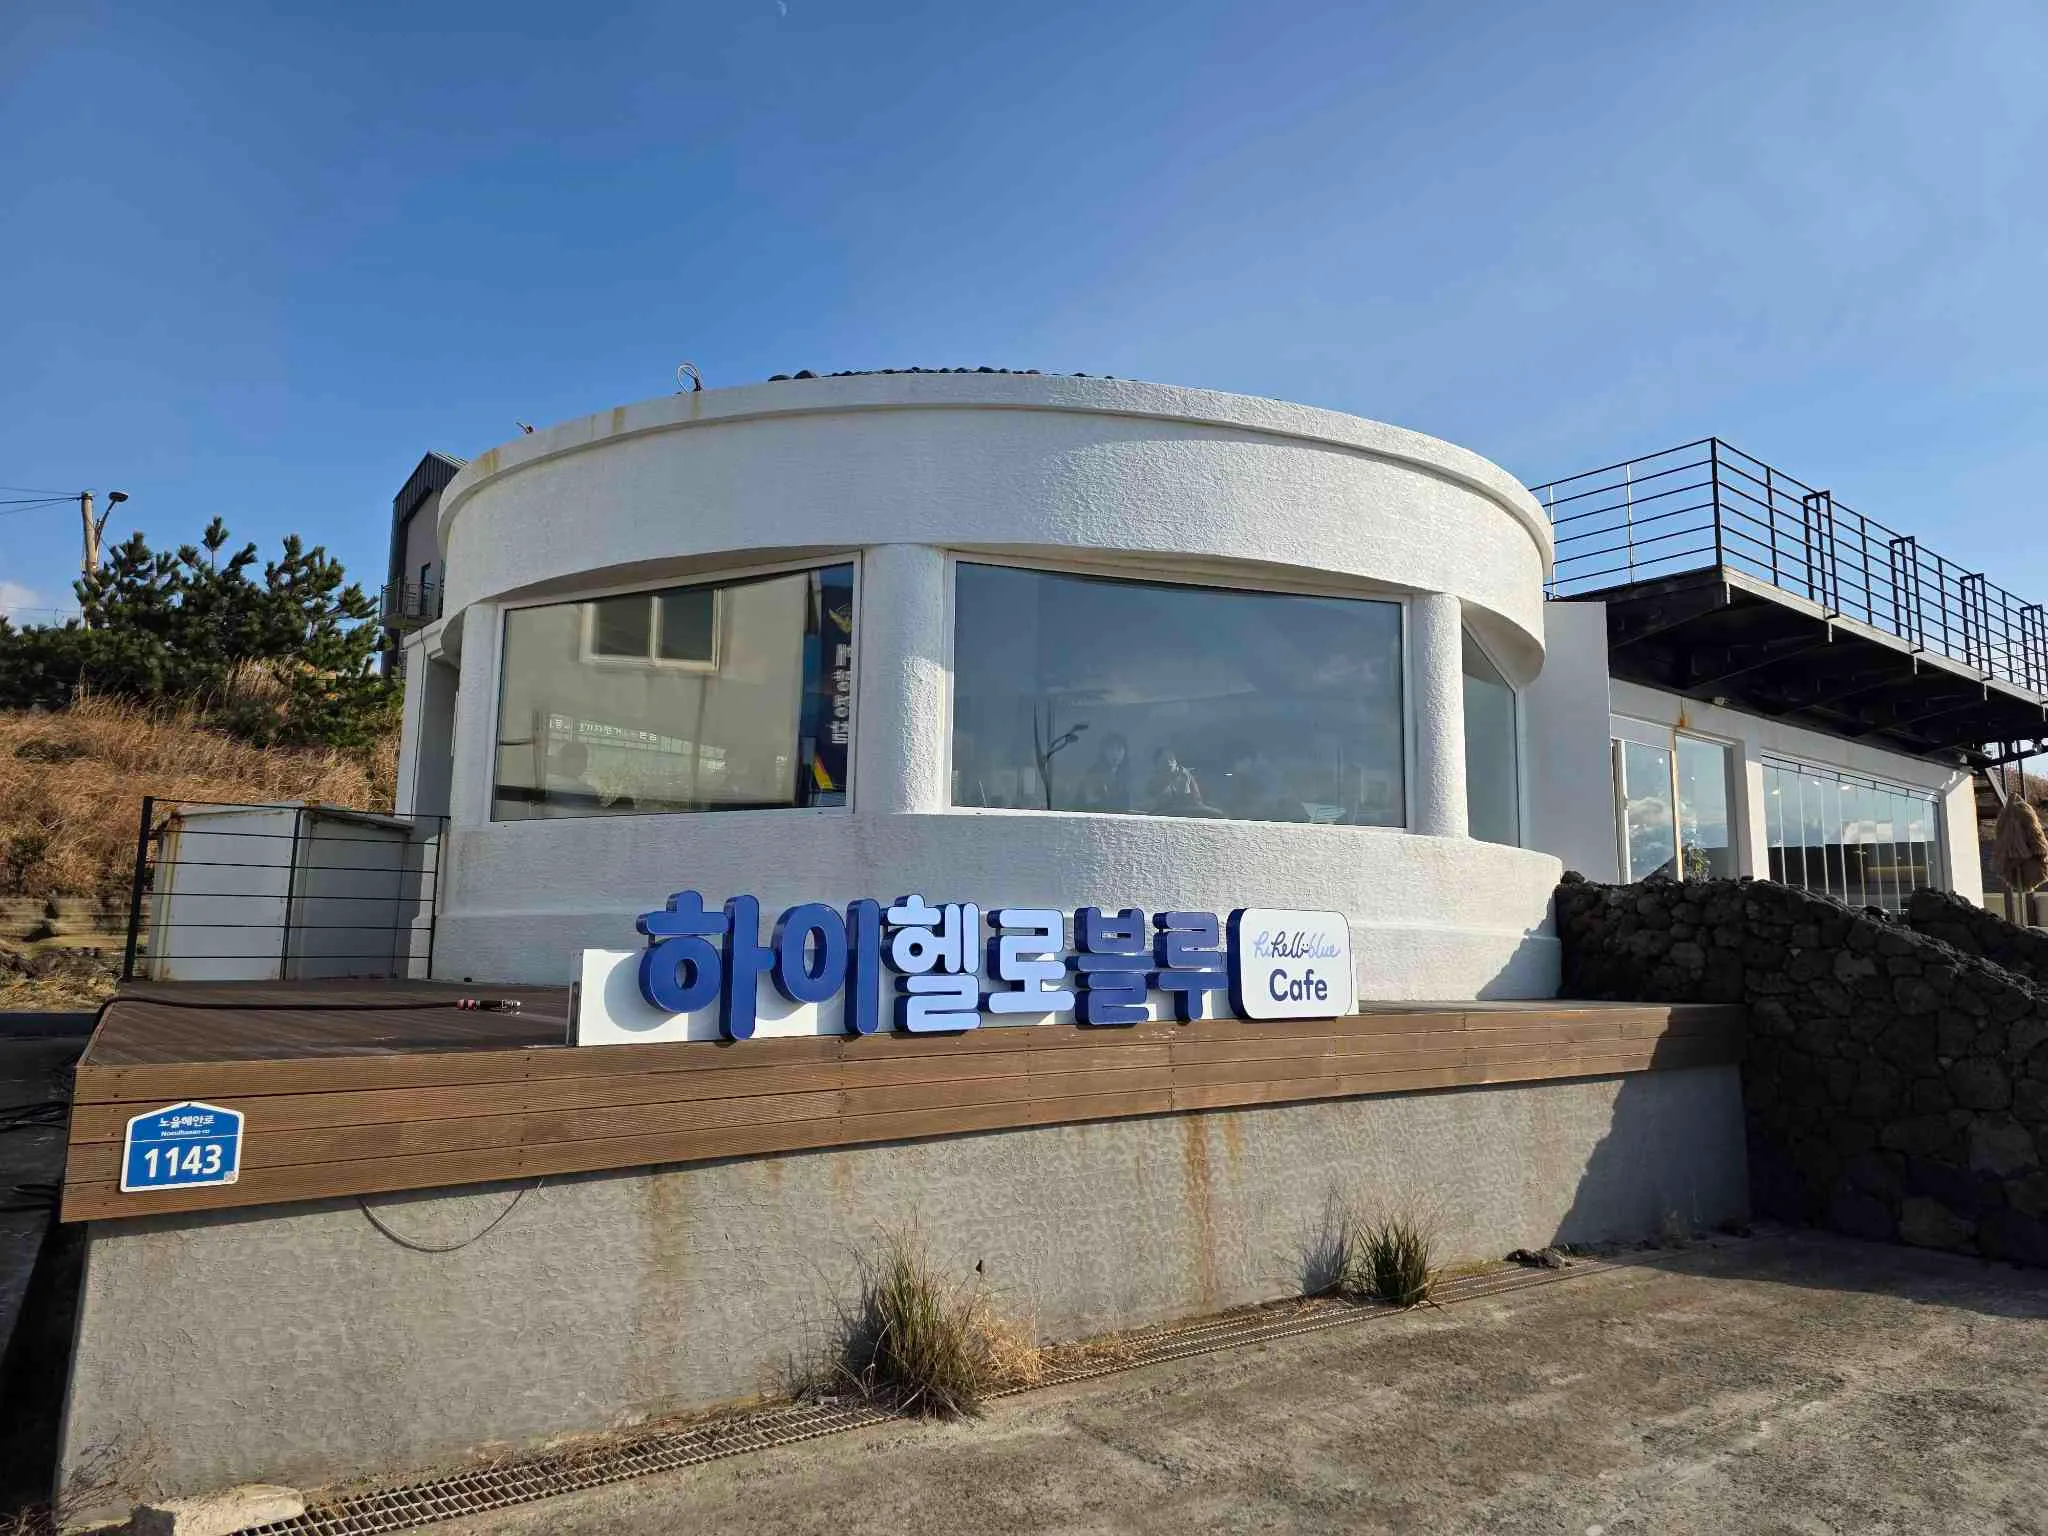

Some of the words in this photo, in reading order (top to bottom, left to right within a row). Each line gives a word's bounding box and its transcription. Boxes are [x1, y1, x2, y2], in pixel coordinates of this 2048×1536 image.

[636, 890, 1229, 1041] 하이헬로블루
[1269, 968, 1328, 1002] Cafe
[144, 1144, 223, 1179] 1143
